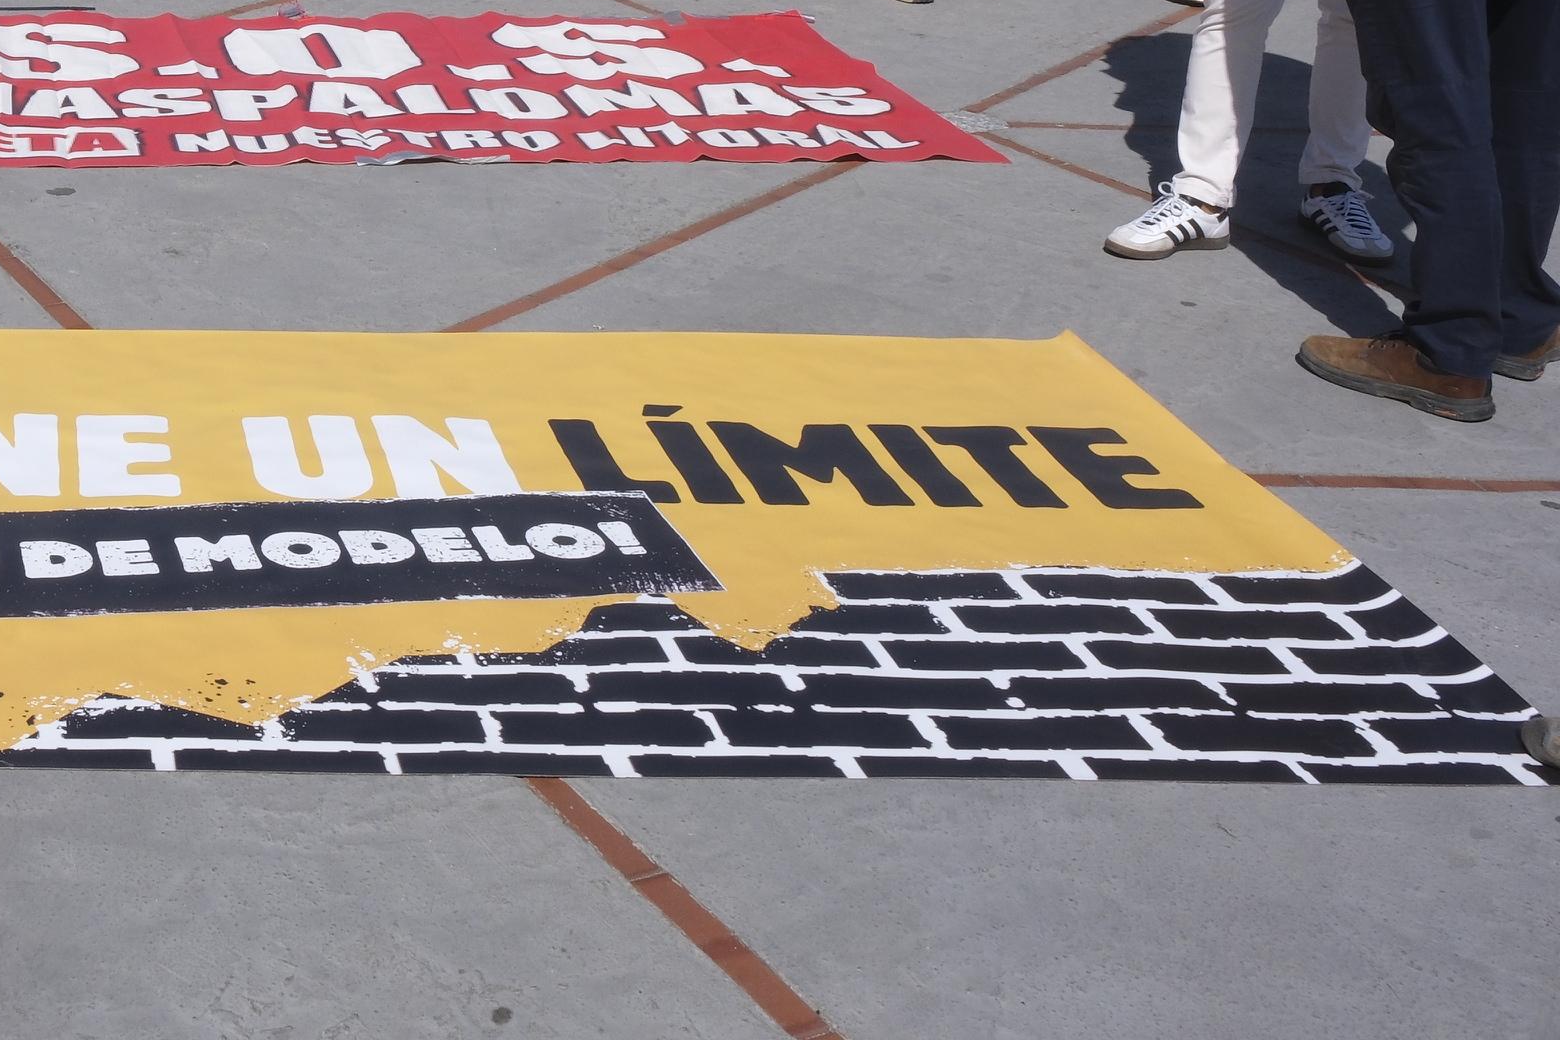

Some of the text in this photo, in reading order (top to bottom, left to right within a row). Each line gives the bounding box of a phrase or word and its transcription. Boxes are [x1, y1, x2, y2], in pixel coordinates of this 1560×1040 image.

[174, 125, 562, 154] NUESTRO
[576, 120, 921, 151] LITORAL
[241, 414, 524, 500] UN
[547, 404, 1206, 510] LÍMITE
[20, 538, 160, 578] DE
[175, 520, 648, 574] MODELO!
